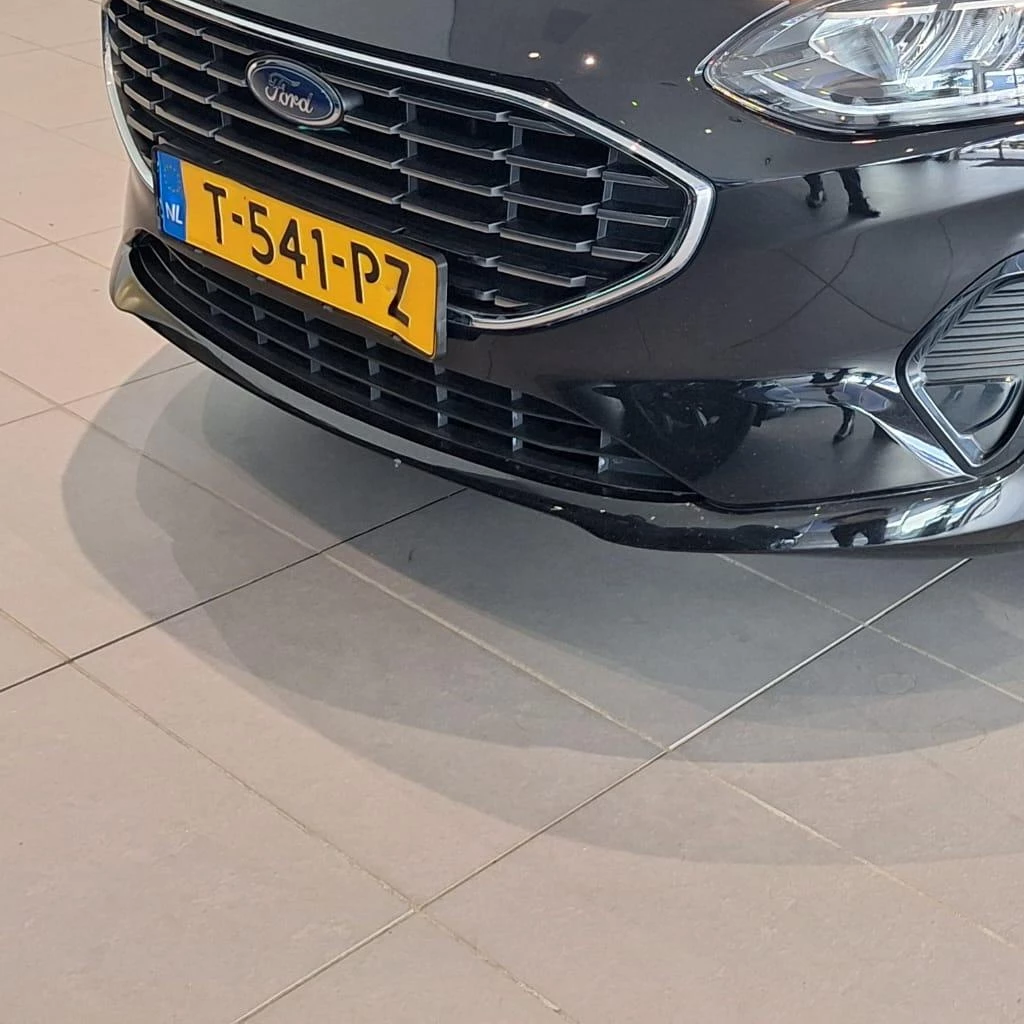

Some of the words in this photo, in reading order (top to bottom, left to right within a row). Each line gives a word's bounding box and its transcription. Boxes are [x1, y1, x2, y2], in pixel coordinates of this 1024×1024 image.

[264, 72, 315, 114] Ford
[165, 206, 184, 225] NL
[203, 182, 410, 328] T-541-PZ
